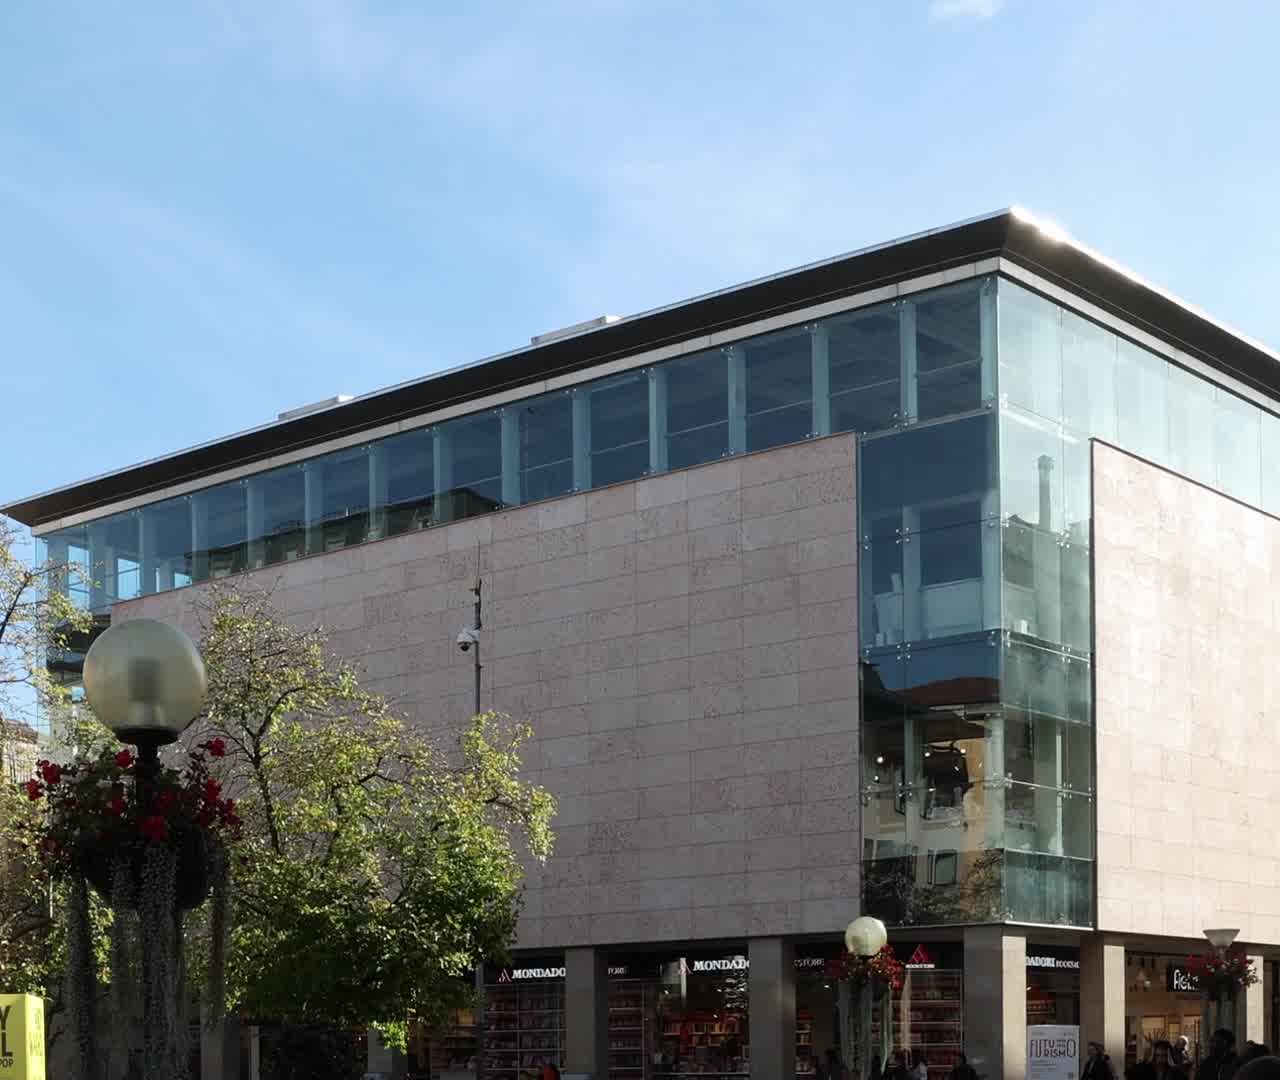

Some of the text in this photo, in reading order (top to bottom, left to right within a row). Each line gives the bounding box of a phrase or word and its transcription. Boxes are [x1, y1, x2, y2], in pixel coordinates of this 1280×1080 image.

[693, 959, 750, 972] MONDAD
[1025, 955, 1056, 968] DADORI
[512, 966, 567, 979] MONDADO
